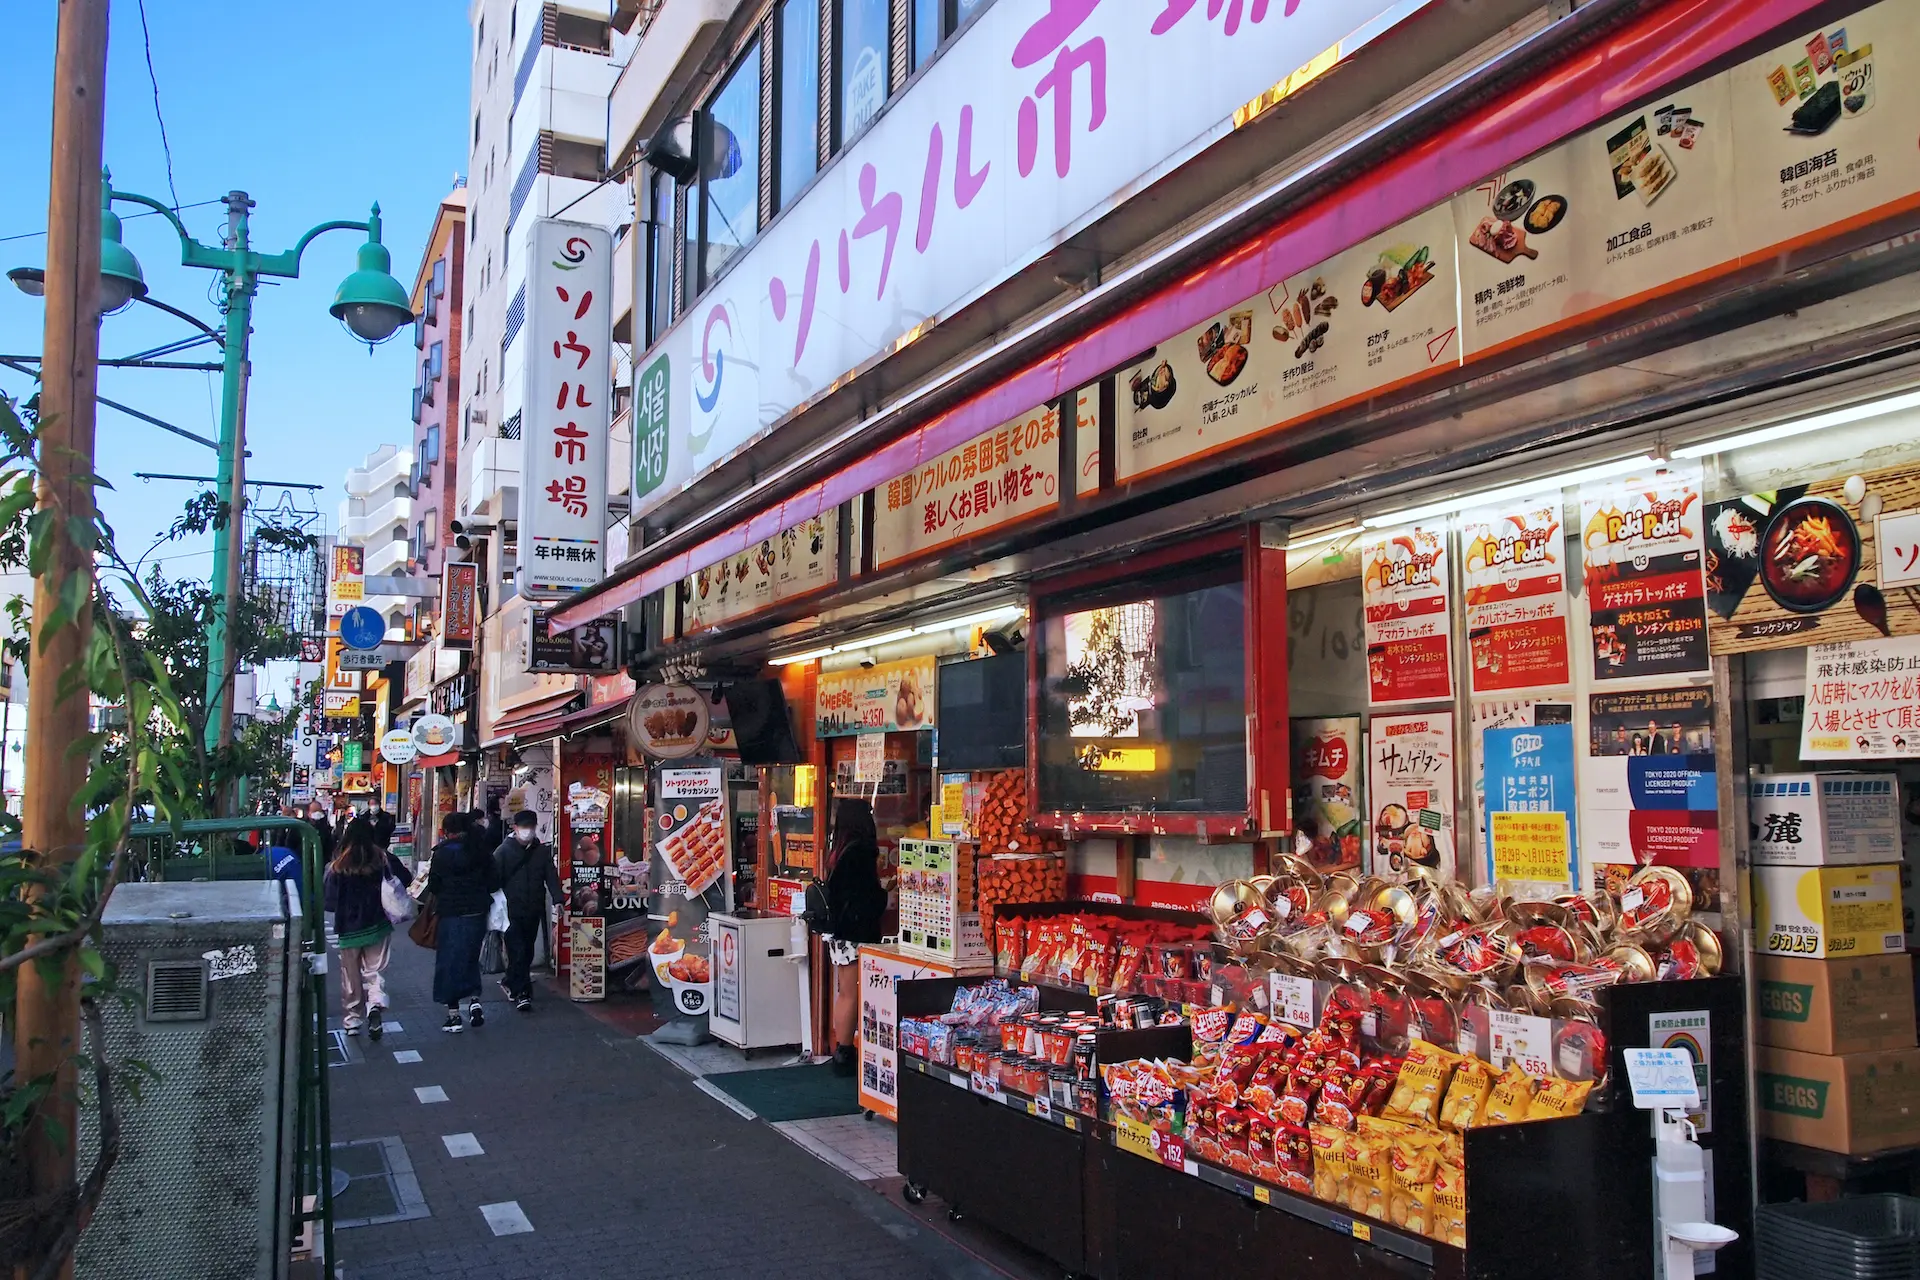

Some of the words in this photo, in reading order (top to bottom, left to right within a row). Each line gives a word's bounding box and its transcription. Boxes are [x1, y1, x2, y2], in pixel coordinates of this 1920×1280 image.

[853, 66, 876, 108] TAKE
[853, 98, 874, 133] OUT
[1780, 148, 1838, 184] 韓国海苔
[1781, 166, 1876, 210] ギフトセット、ふりかけ海苔
[1606, 222, 1652, 252] 加工食品
[1474, 274, 1525, 305] 精肉・海鮮物
[1367, 329, 1390, 347] おかず
[1282, 361, 1314, 382] 手作り屋台
[545, 285, 594, 519] ソウル市場
[639, 373, 666, 429] 서울
[1202, 383, 1258, 414] 市場チーズタッカルビ
[1203, 404, 1238, 425] 1人前、2人前
[637, 427, 666, 484] 시장
[1650, 499, 1681, 515] ポキポキ
[534, 544, 597, 563] 年中無休
[1634, 554, 1647, 566] 03
[533, 574, 597, 584] WWW.SEOUL-ICHIBA.COM
[1507, 578, 1517, 588] 02
[1603, 582, 1688, 608] ゲキカラトッポギ
[1477, 602, 1556, 626] カルボナーラトッポギ
[1618, 608, 1671, 627] お水を加えて
[1377, 622, 1436, 641] アマカラトッポギ
[1494, 626, 1537, 641] お水を加えて
[1753, 620, 1802, 635] ユッケジャン
[1387, 643, 1423, 655] お水を加えて
[1814, 649, 1879, 661] コロナ対策として
[1815, 641, 1852, 652] お客様各位
[343, 655, 383, 665] 歩行者優先
[1817, 655, 1920, 678] 飛沫感染防止
[820, 689, 853, 710] CHEESE
[823, 711, 849, 735] BALL
[862, 708, 884, 728] ¥350
[1305, 747, 1344, 767] キムチ
[1379, 743, 1443, 777] サムゲタン
[1515, 756, 1541, 768] トラベル
[1507, 775, 1548, 786] 地域共通
[1508, 787, 1549, 799] クーポン
[1508, 800, 1549, 812] 取扱店舗
[1647, 826, 1664, 834] TOKYO
[1665, 826, 1678, 834] 2020
[1679, 827, 1704, 835] OFFICIAL
[1647, 835, 1672, 843] LICENSED
[1673, 836, 1698, 844] PRODUCT
[1775, 924, 1786, 932] 新鮮
[1788, 925, 1801, 933] 安全
[1769, 933, 1818, 953] タカムラ
[1828, 937, 1855, 951] タカムラ
[1763, 989, 1804, 1014] EGGS
[1773, 1083, 1818, 1110] EGGS
